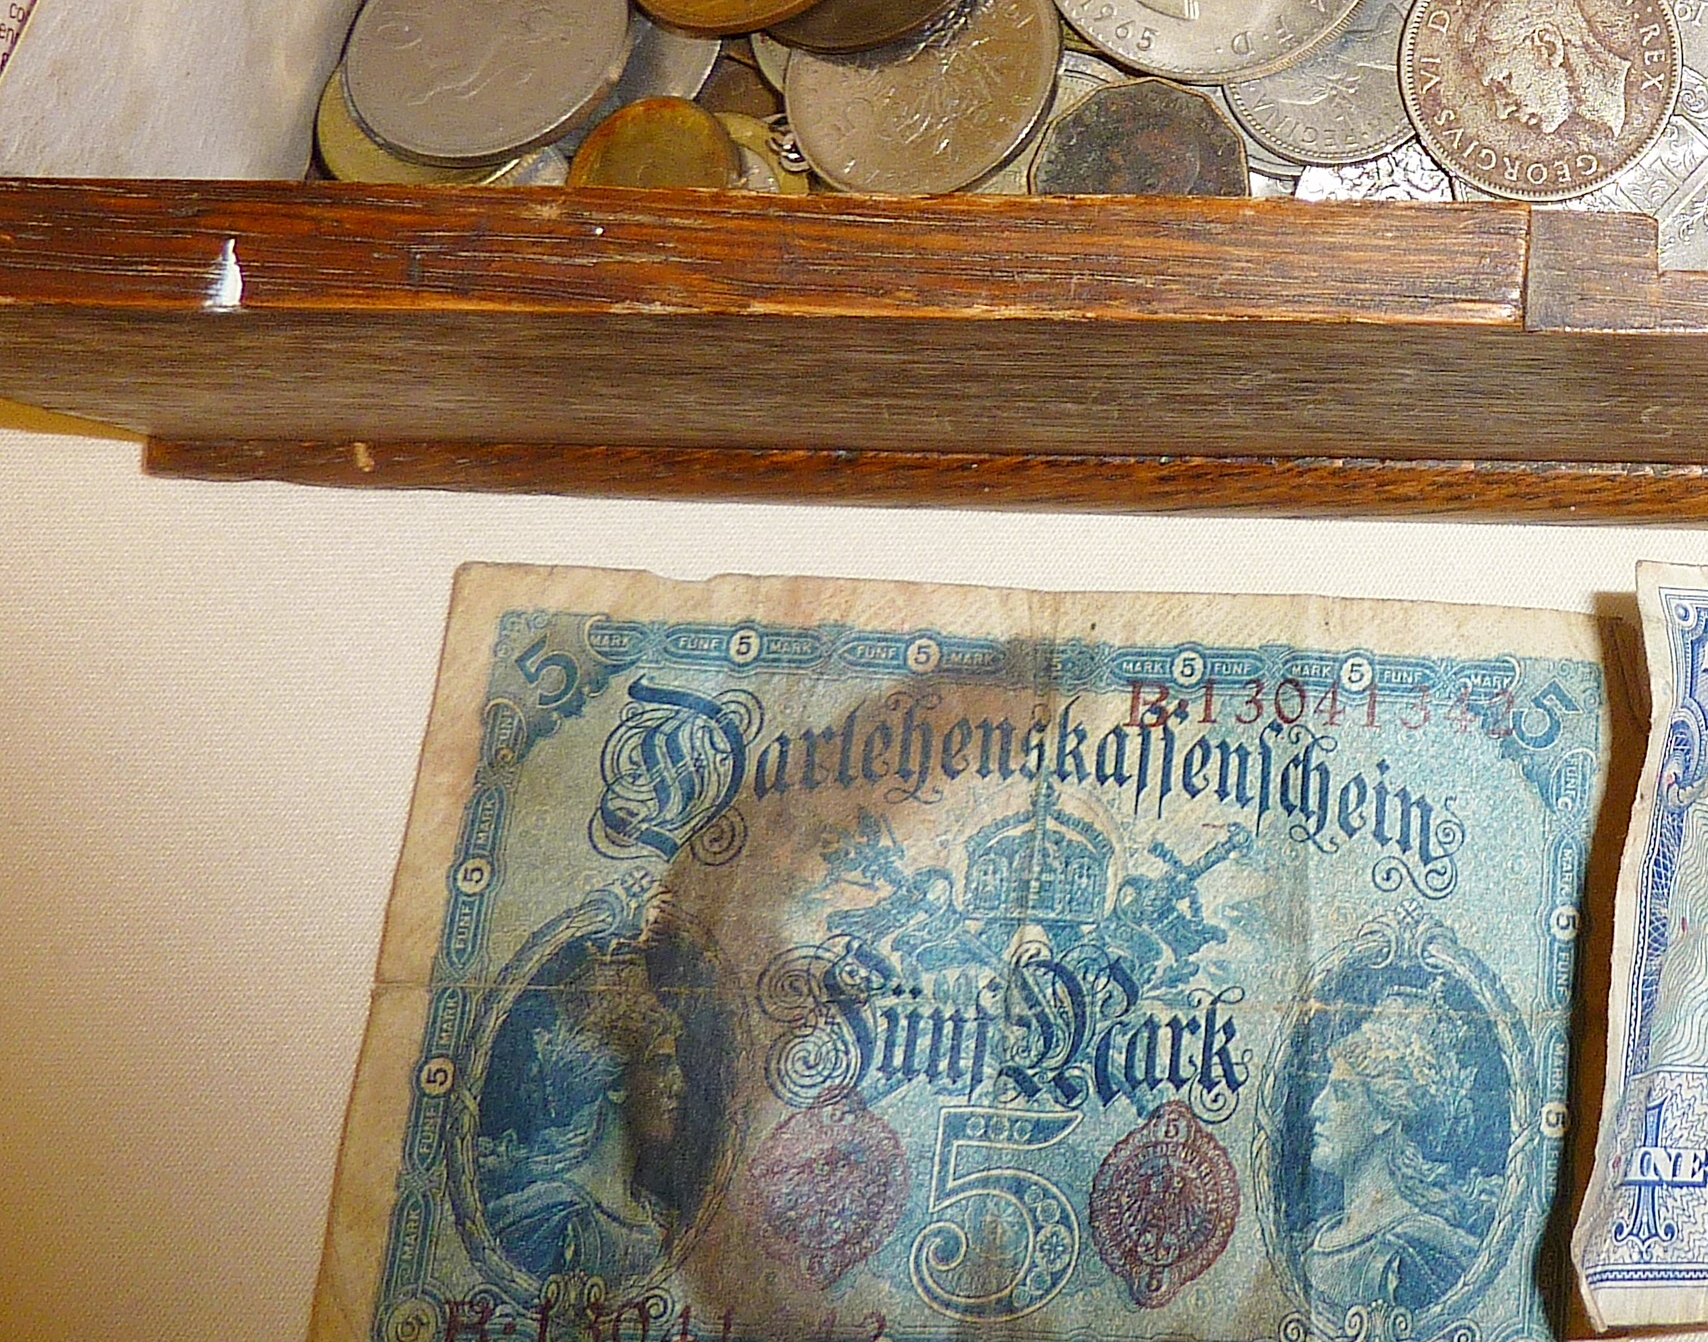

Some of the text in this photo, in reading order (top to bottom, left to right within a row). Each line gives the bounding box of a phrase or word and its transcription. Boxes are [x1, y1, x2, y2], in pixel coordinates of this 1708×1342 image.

[1440, 108, 1598, 187] GEORGIVS
[1638, 23, 1664, 91] REX
[513, 633, 580, 709] 5
[736, 634, 754, 656] 5
[913, 642, 935, 667] 5
[1121, 660, 1163, 674] MARK
[1180, 656, 1197, 678] 5
[1291, 664, 1332, 678] MARK
[1347, 661, 1365, 684] 5
[1510, 678, 1585, 750] 5
[463, 865, 485, 886] 5
[1556, 911, 1577, 932] 5
[426, 1066, 449, 1088] 5
[1002, 938, 1253, 1124] Mark
[909, 1106, 1083, 1321] 5
